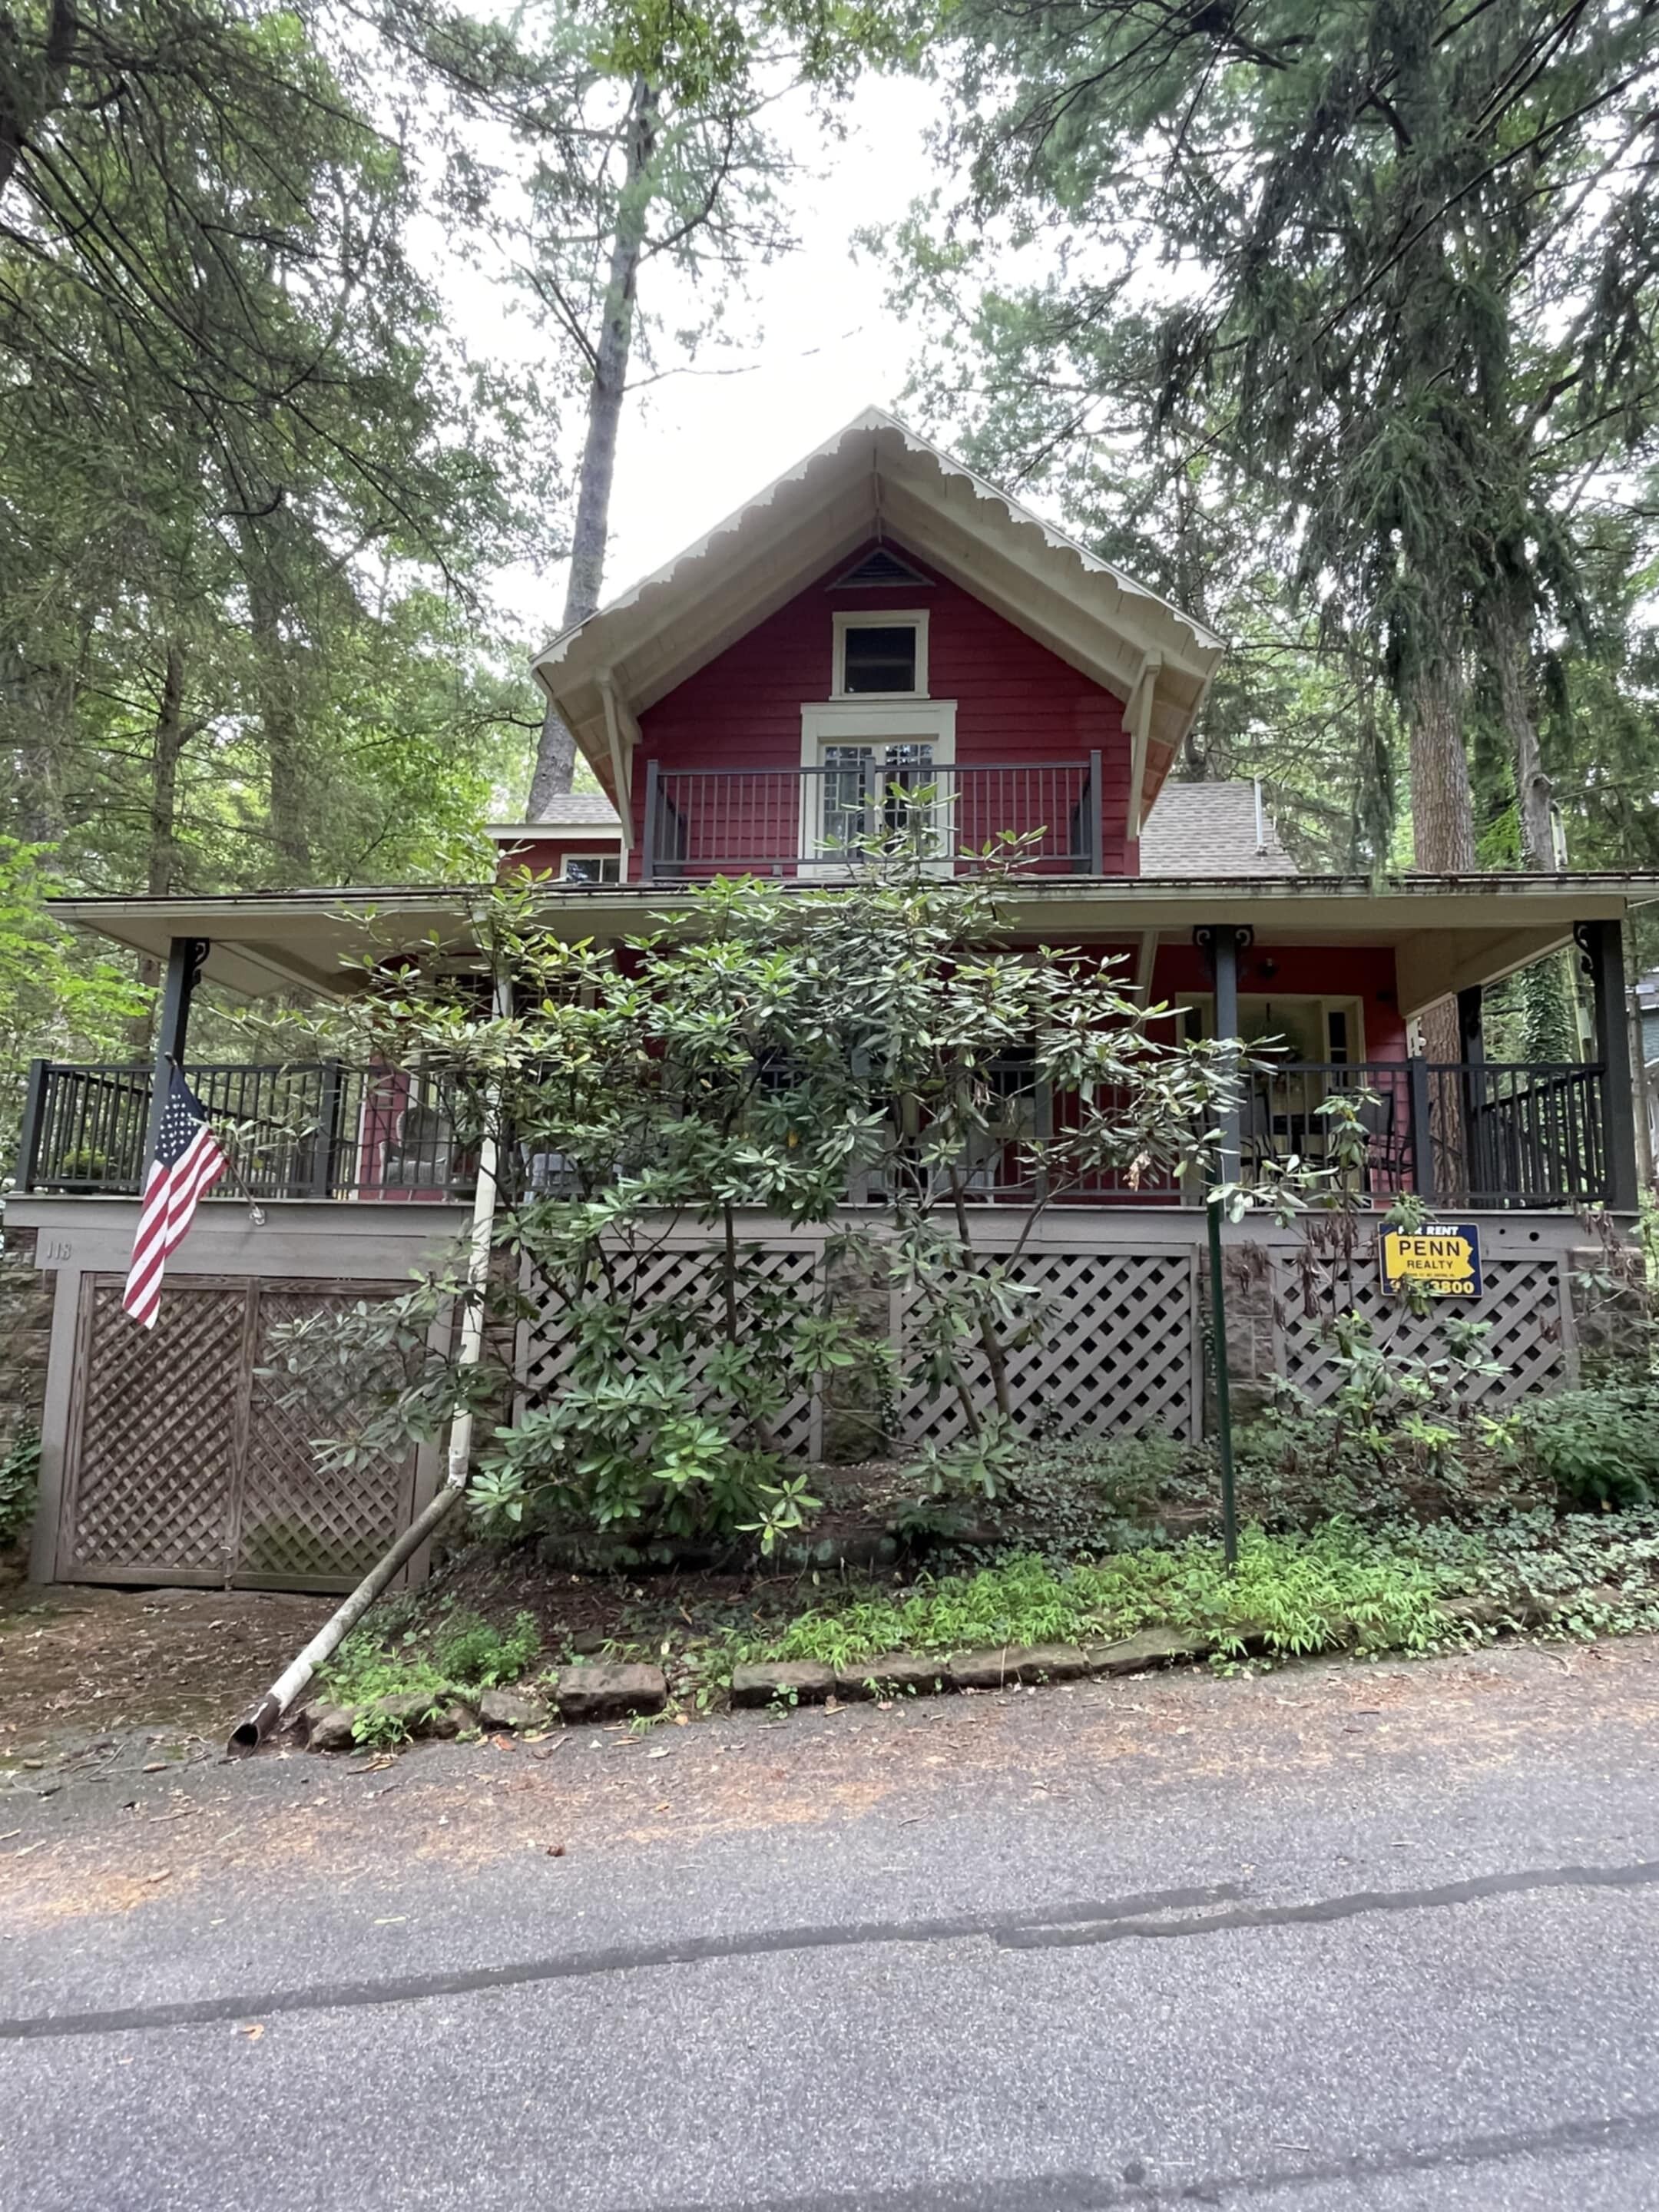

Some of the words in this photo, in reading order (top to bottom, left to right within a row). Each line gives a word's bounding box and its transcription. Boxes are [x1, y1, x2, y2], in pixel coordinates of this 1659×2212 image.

[1398, 1225, 1422, 1235] FR
[1426, 1226, 1459, 1236] RENT
[48, 1241, 71, 1260] 118
[1399, 1240, 1460, 1257] PENN
[1407, 1260, 1453, 1270] REALTY
